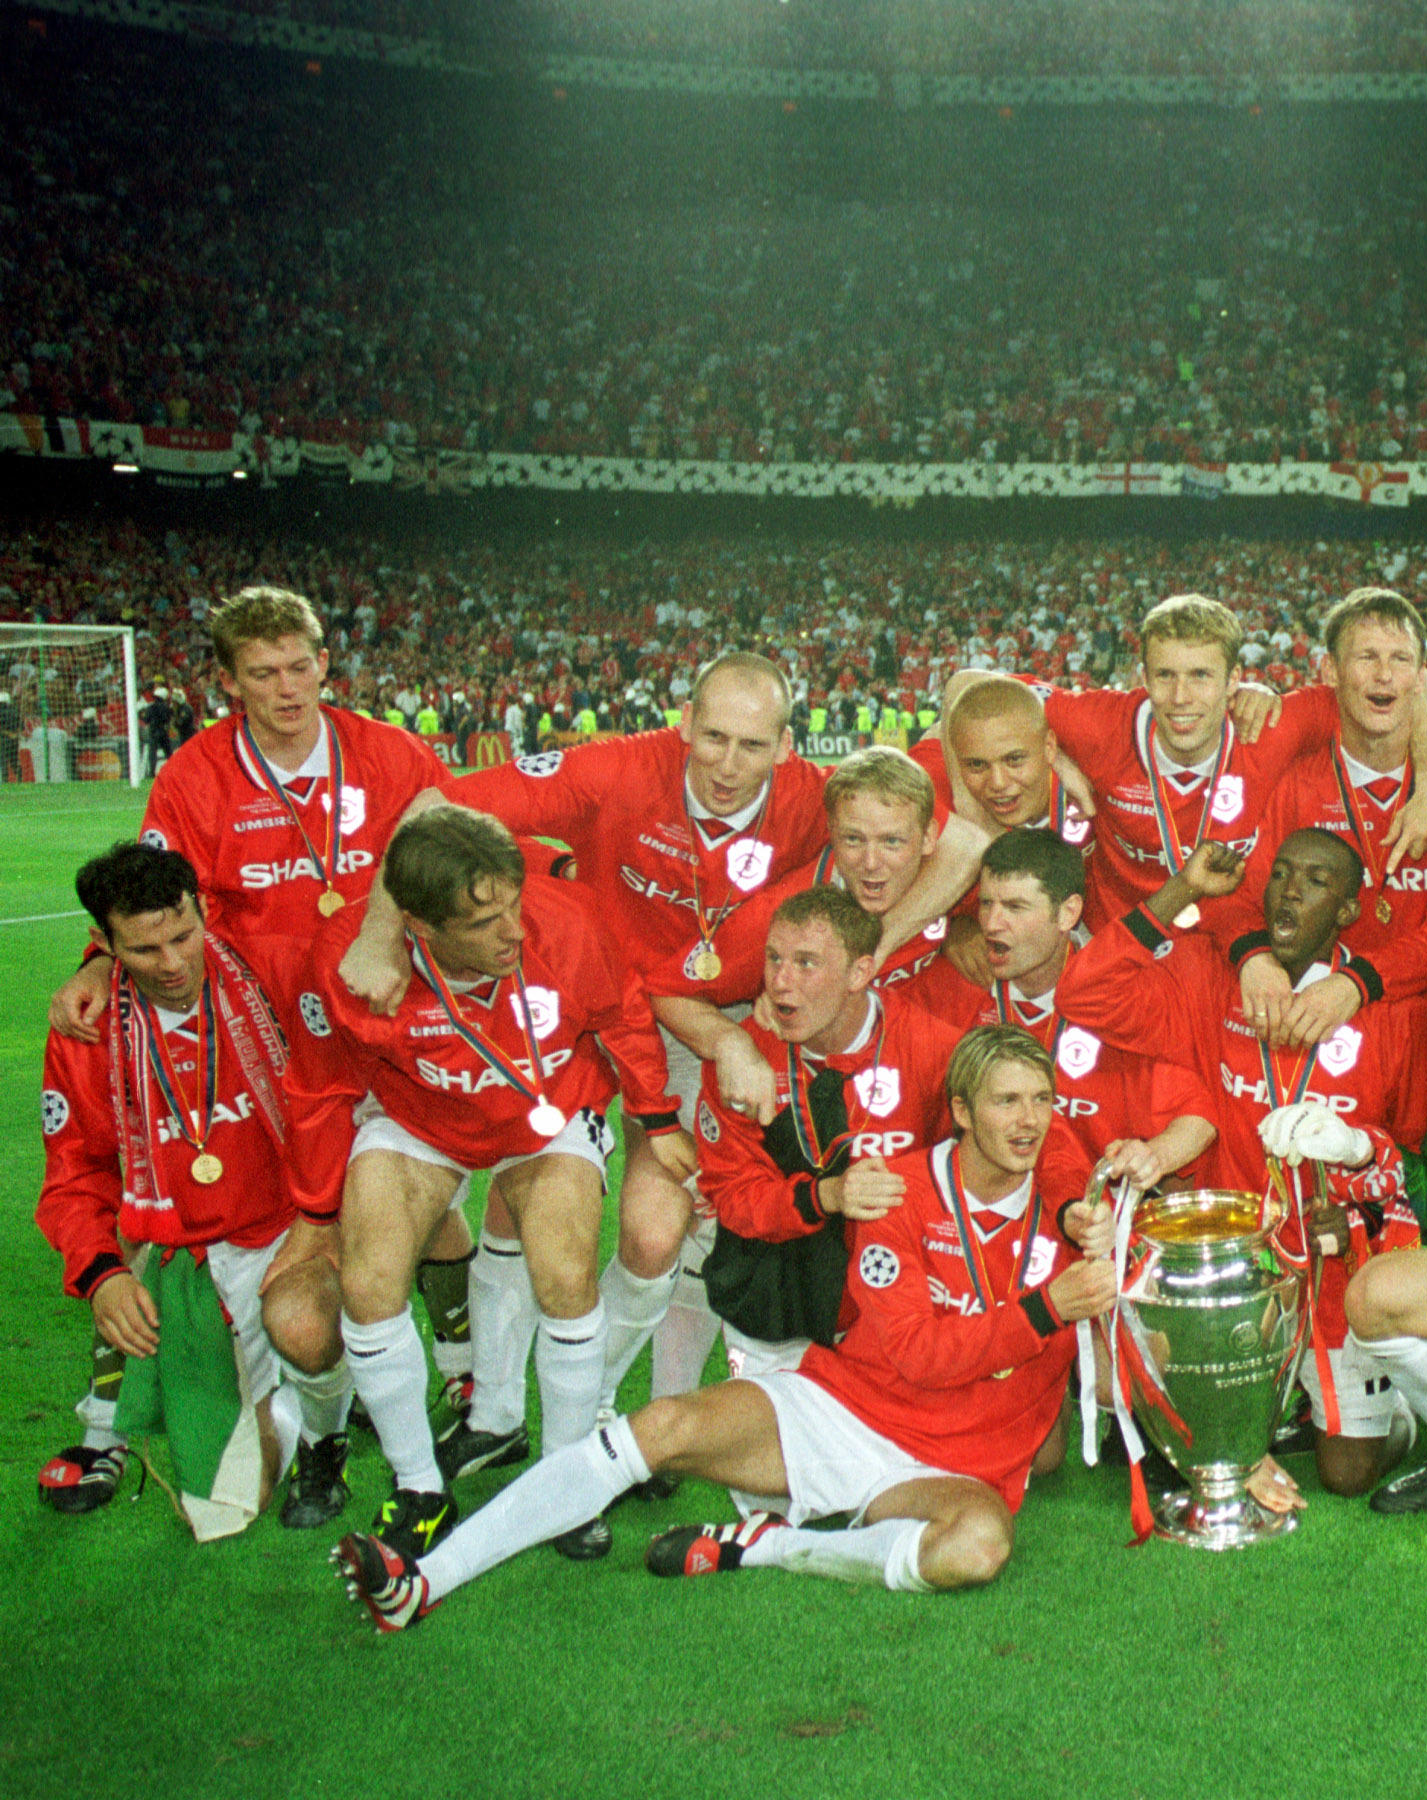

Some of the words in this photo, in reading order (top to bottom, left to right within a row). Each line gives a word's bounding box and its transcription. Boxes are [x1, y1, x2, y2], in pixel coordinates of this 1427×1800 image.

[798, 732, 850, 755] tion
[1314, 821, 1374, 831] UMBO
[239, 849, 375, 889] SHARP
[1223, 1018, 1258, 1038] UMB
[1220, 1062, 1359, 1113] SHP
